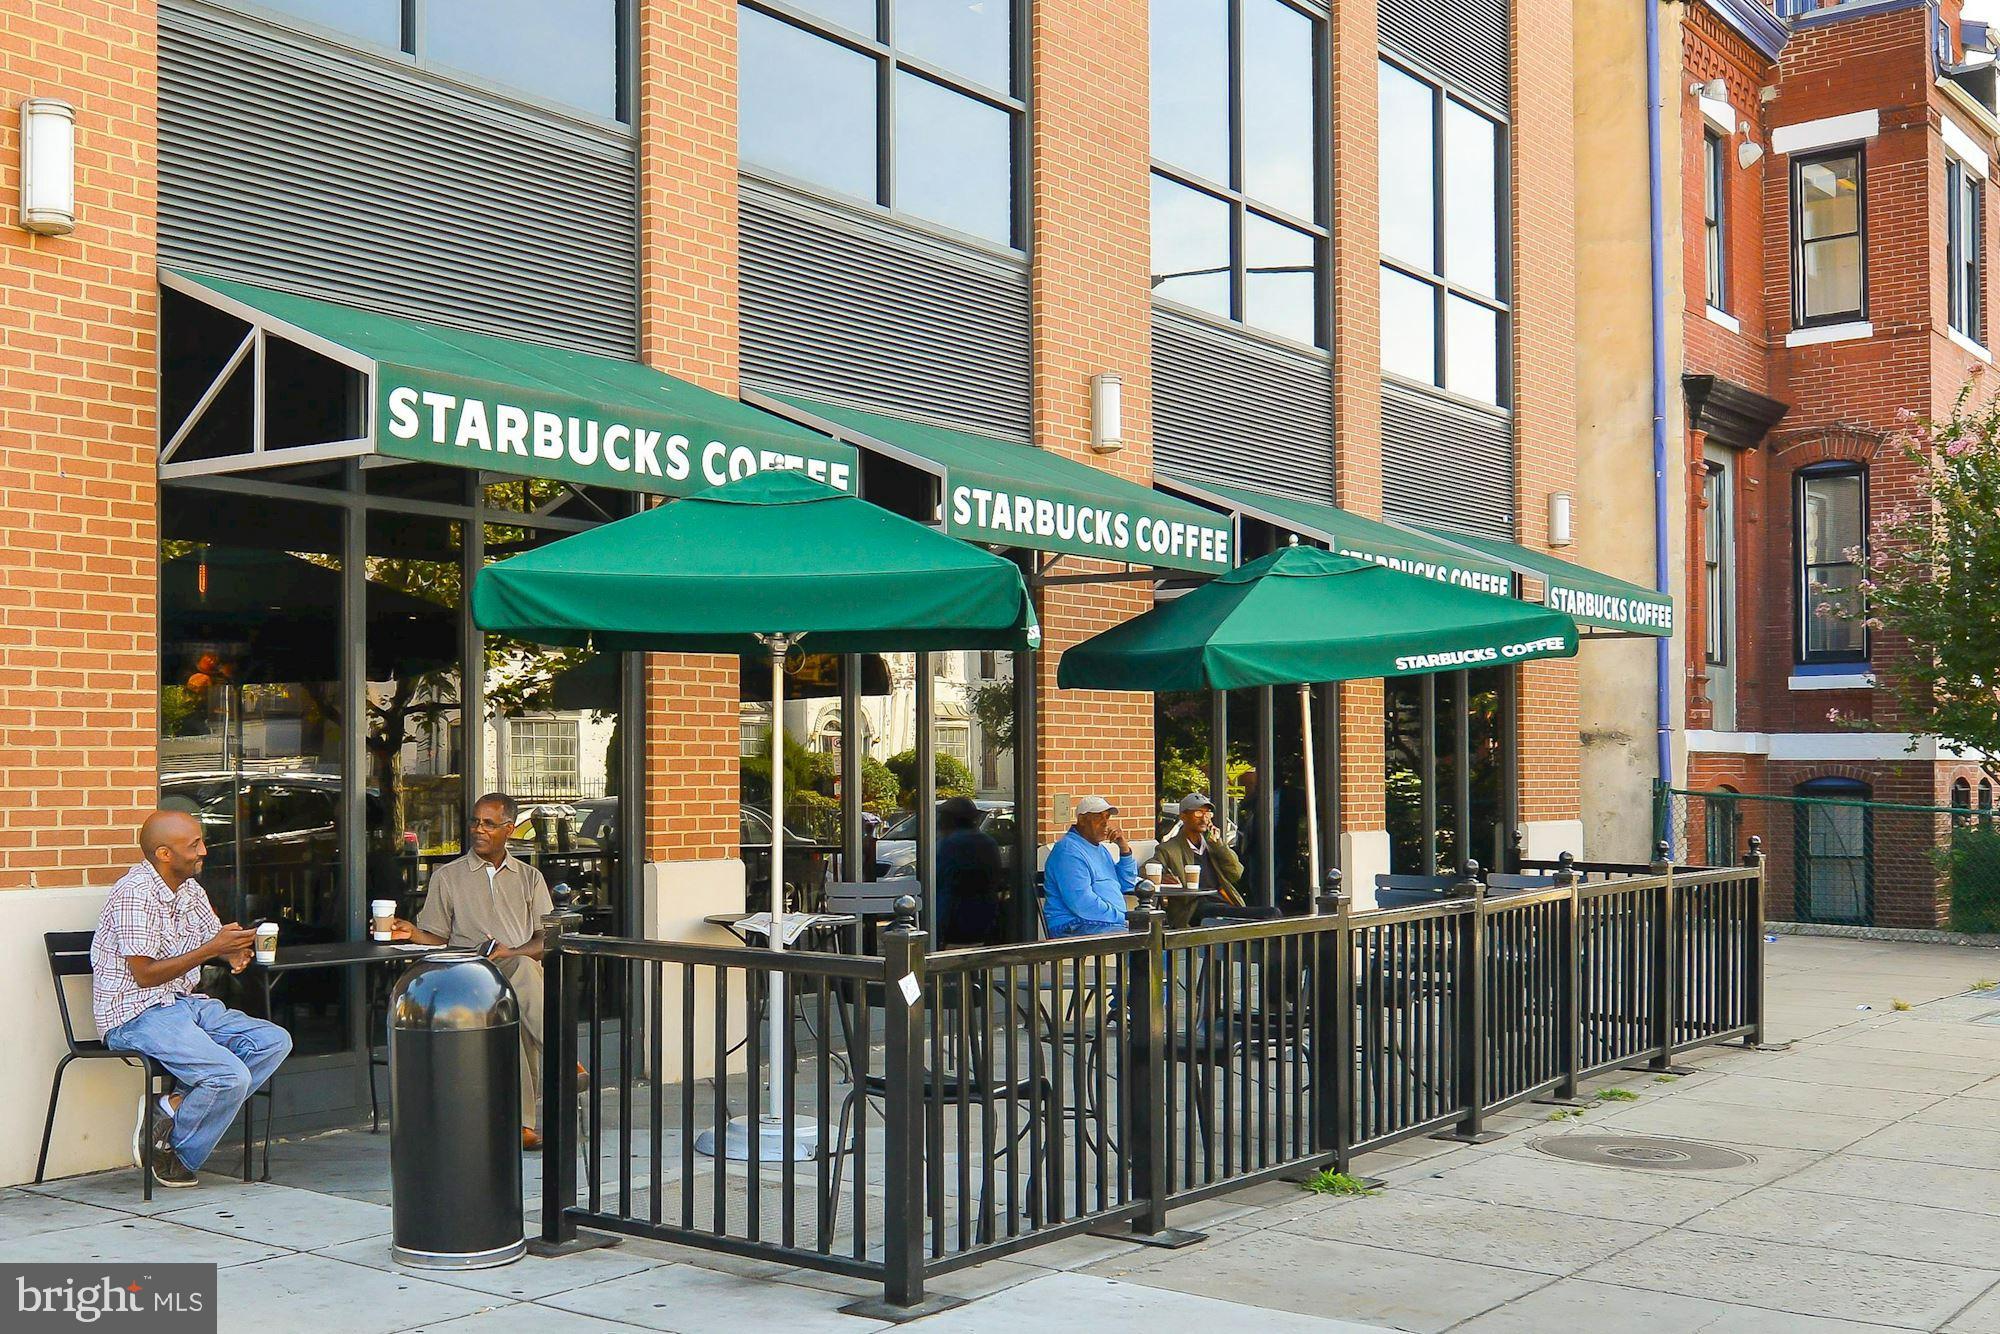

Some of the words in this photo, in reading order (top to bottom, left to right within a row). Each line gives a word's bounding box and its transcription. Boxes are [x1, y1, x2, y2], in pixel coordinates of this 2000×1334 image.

[388, 387, 690, 480] STARBUCKS
[953, 486, 1128, 548] STARBUCKS
[1136, 517, 1227, 563] COFFEE
[1551, 587, 1627, 622] STARBUCKS
[1629, 600, 1672, 628] COFFEE
[1395, 648, 1498, 670] STARBUCKS
[1501, 637, 1565, 657] COFFEE
